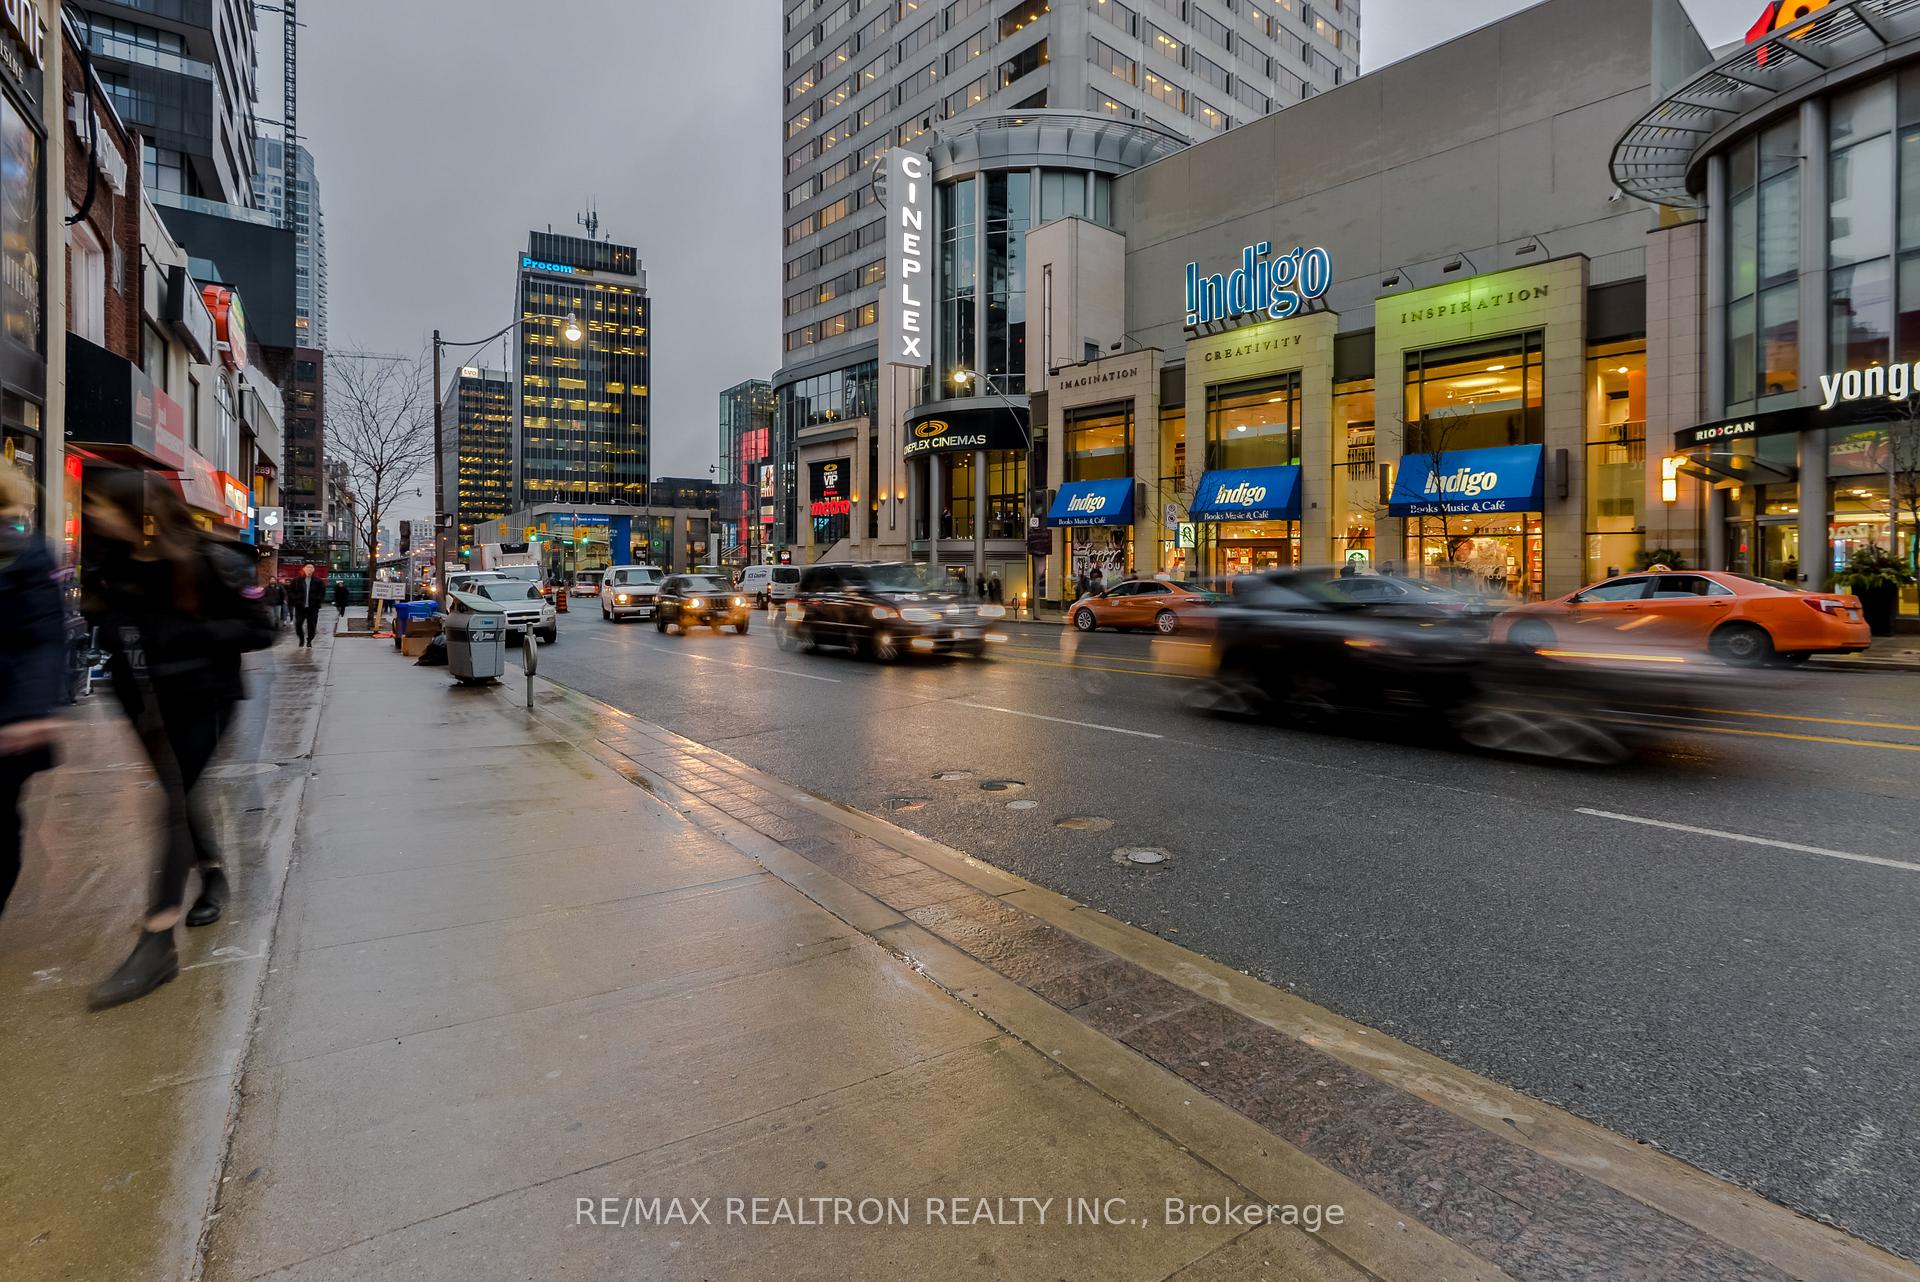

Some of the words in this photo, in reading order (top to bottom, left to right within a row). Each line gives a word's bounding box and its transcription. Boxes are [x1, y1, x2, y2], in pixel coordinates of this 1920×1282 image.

[522, 257, 572, 274] Procom
[902, 157, 922, 358] CINEPLEX
[1401, 285, 1549, 324] INSPIRATION
[1204, 335, 1302, 362] CREATIVITY
[1060, 367, 1138, 390] IMAGINATION
[931, 434, 987, 448] CINEMAS
[823, 474, 838, 486] VIP
[810, 500, 851, 516] metro
[1204, 512, 1224, 520] Books
[1225, 512, 1245, 520] Music
[1246, 512, 1253, 520] &
[1253, 510, 1269, 519] Café
[1410, 504, 1438, 514] Books
[1442, 502, 1470, 513] Music
[1471, 502, 1482, 512] &
[1482, 500, 1506, 511] Café
[1077, 562, 1097, 570] NEW
[1102, 562, 1121, 570] YOU
